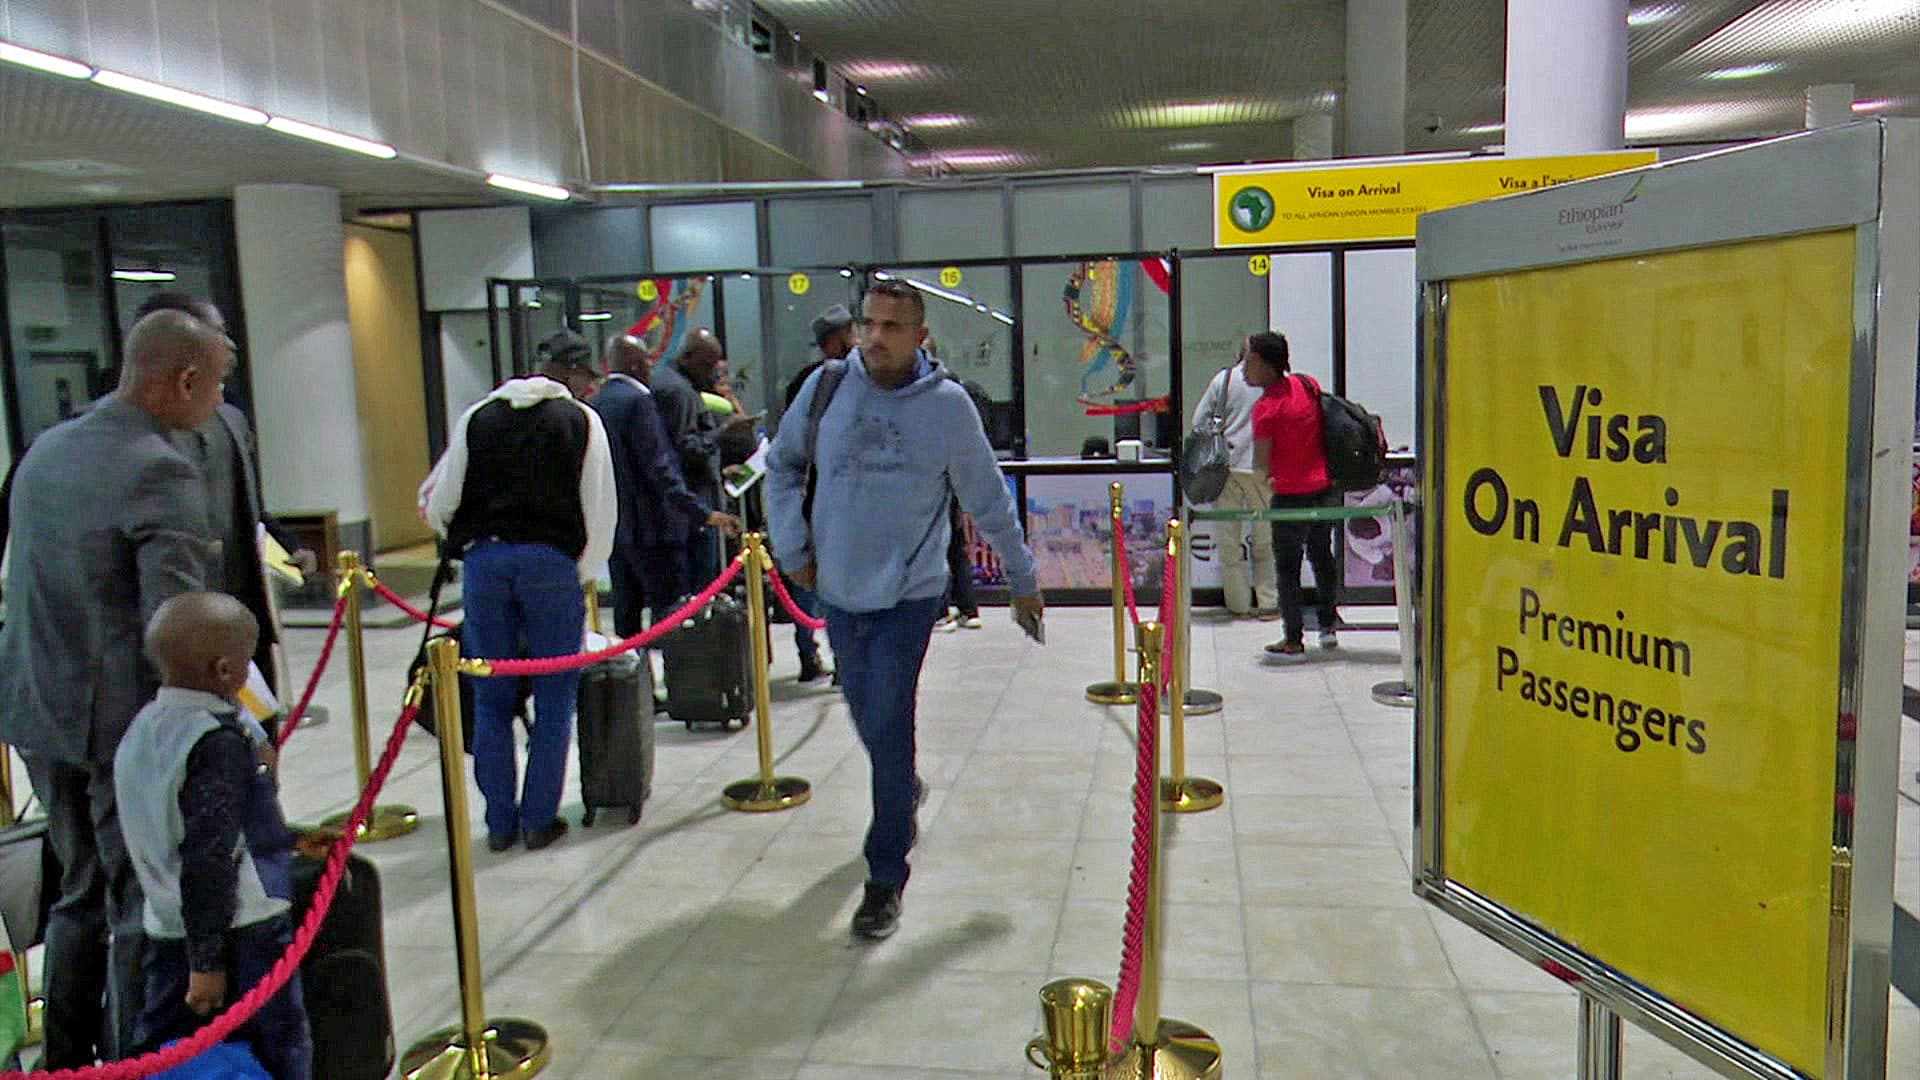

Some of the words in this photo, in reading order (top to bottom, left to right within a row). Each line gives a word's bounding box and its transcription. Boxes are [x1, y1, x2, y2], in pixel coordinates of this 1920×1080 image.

[1307, 186, 1335, 199] Visa
[1338, 187, 1355, 197] on
[1357, 181, 1401, 196] Arrival
[1499, 177, 1527, 190] Visa
[1308, 209, 1340, 219] AFRICAN
[1558, 203, 1624, 225] Ethiopian
[1251, 259, 1267, 271] 14
[792, 278, 806, 289] 17
[1538, 384, 1668, 465] Visa
[1463, 466, 1540, 544] On
[1557, 476, 1790, 580] Arrival
[1519, 586, 1692, 677] Premium
[1496, 645, 1708, 755] Passengers
